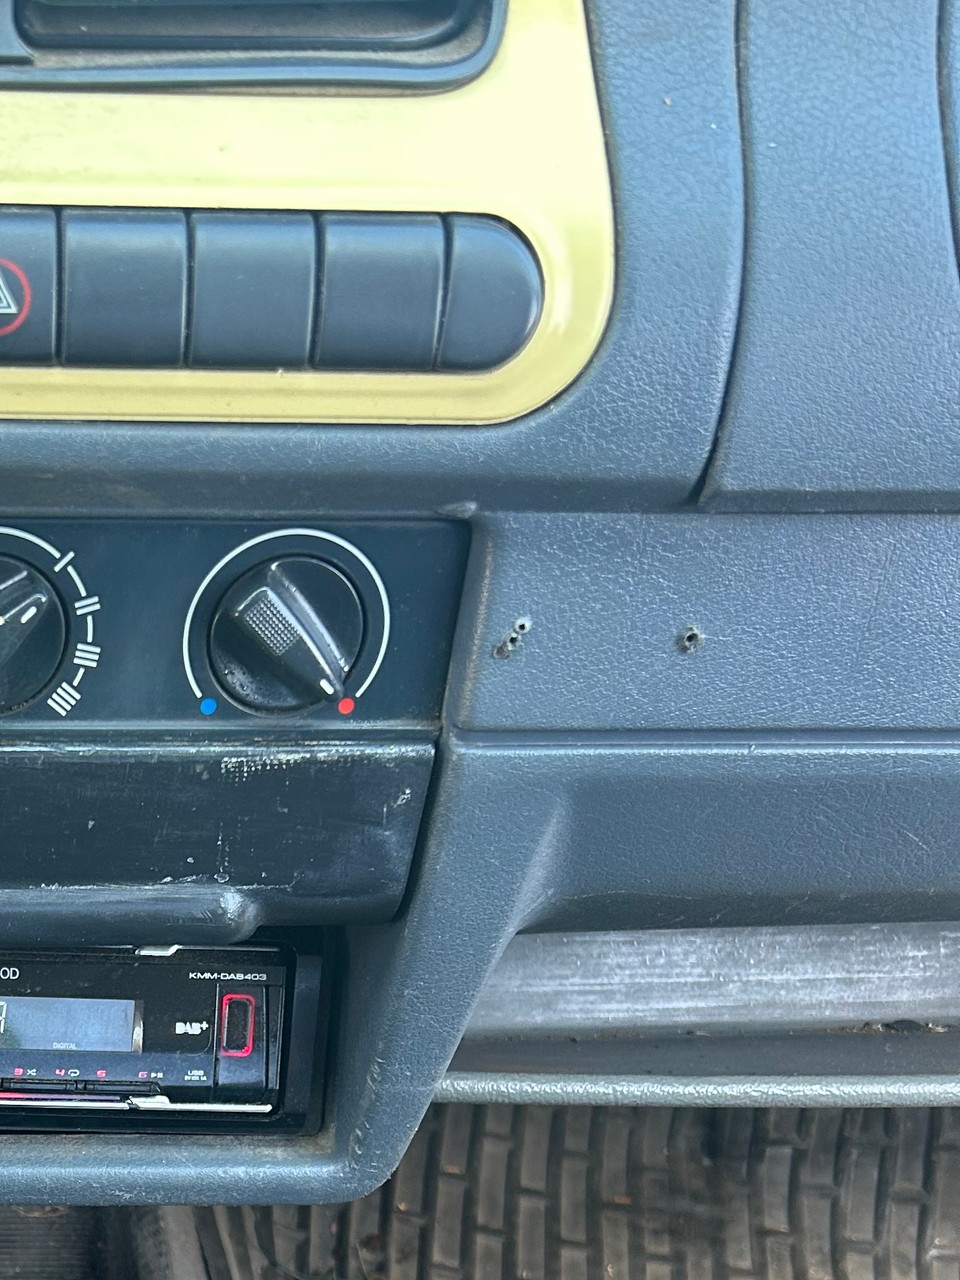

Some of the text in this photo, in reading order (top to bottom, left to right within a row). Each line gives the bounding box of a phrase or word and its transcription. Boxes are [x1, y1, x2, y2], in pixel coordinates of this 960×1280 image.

[188, 971, 267, 981] KMM-DAB403
[52, 1042, 77, 1050] DIGITAL
[13, 1067, 24, 1076] 3
[55, 1068, 66, 1076] 4
